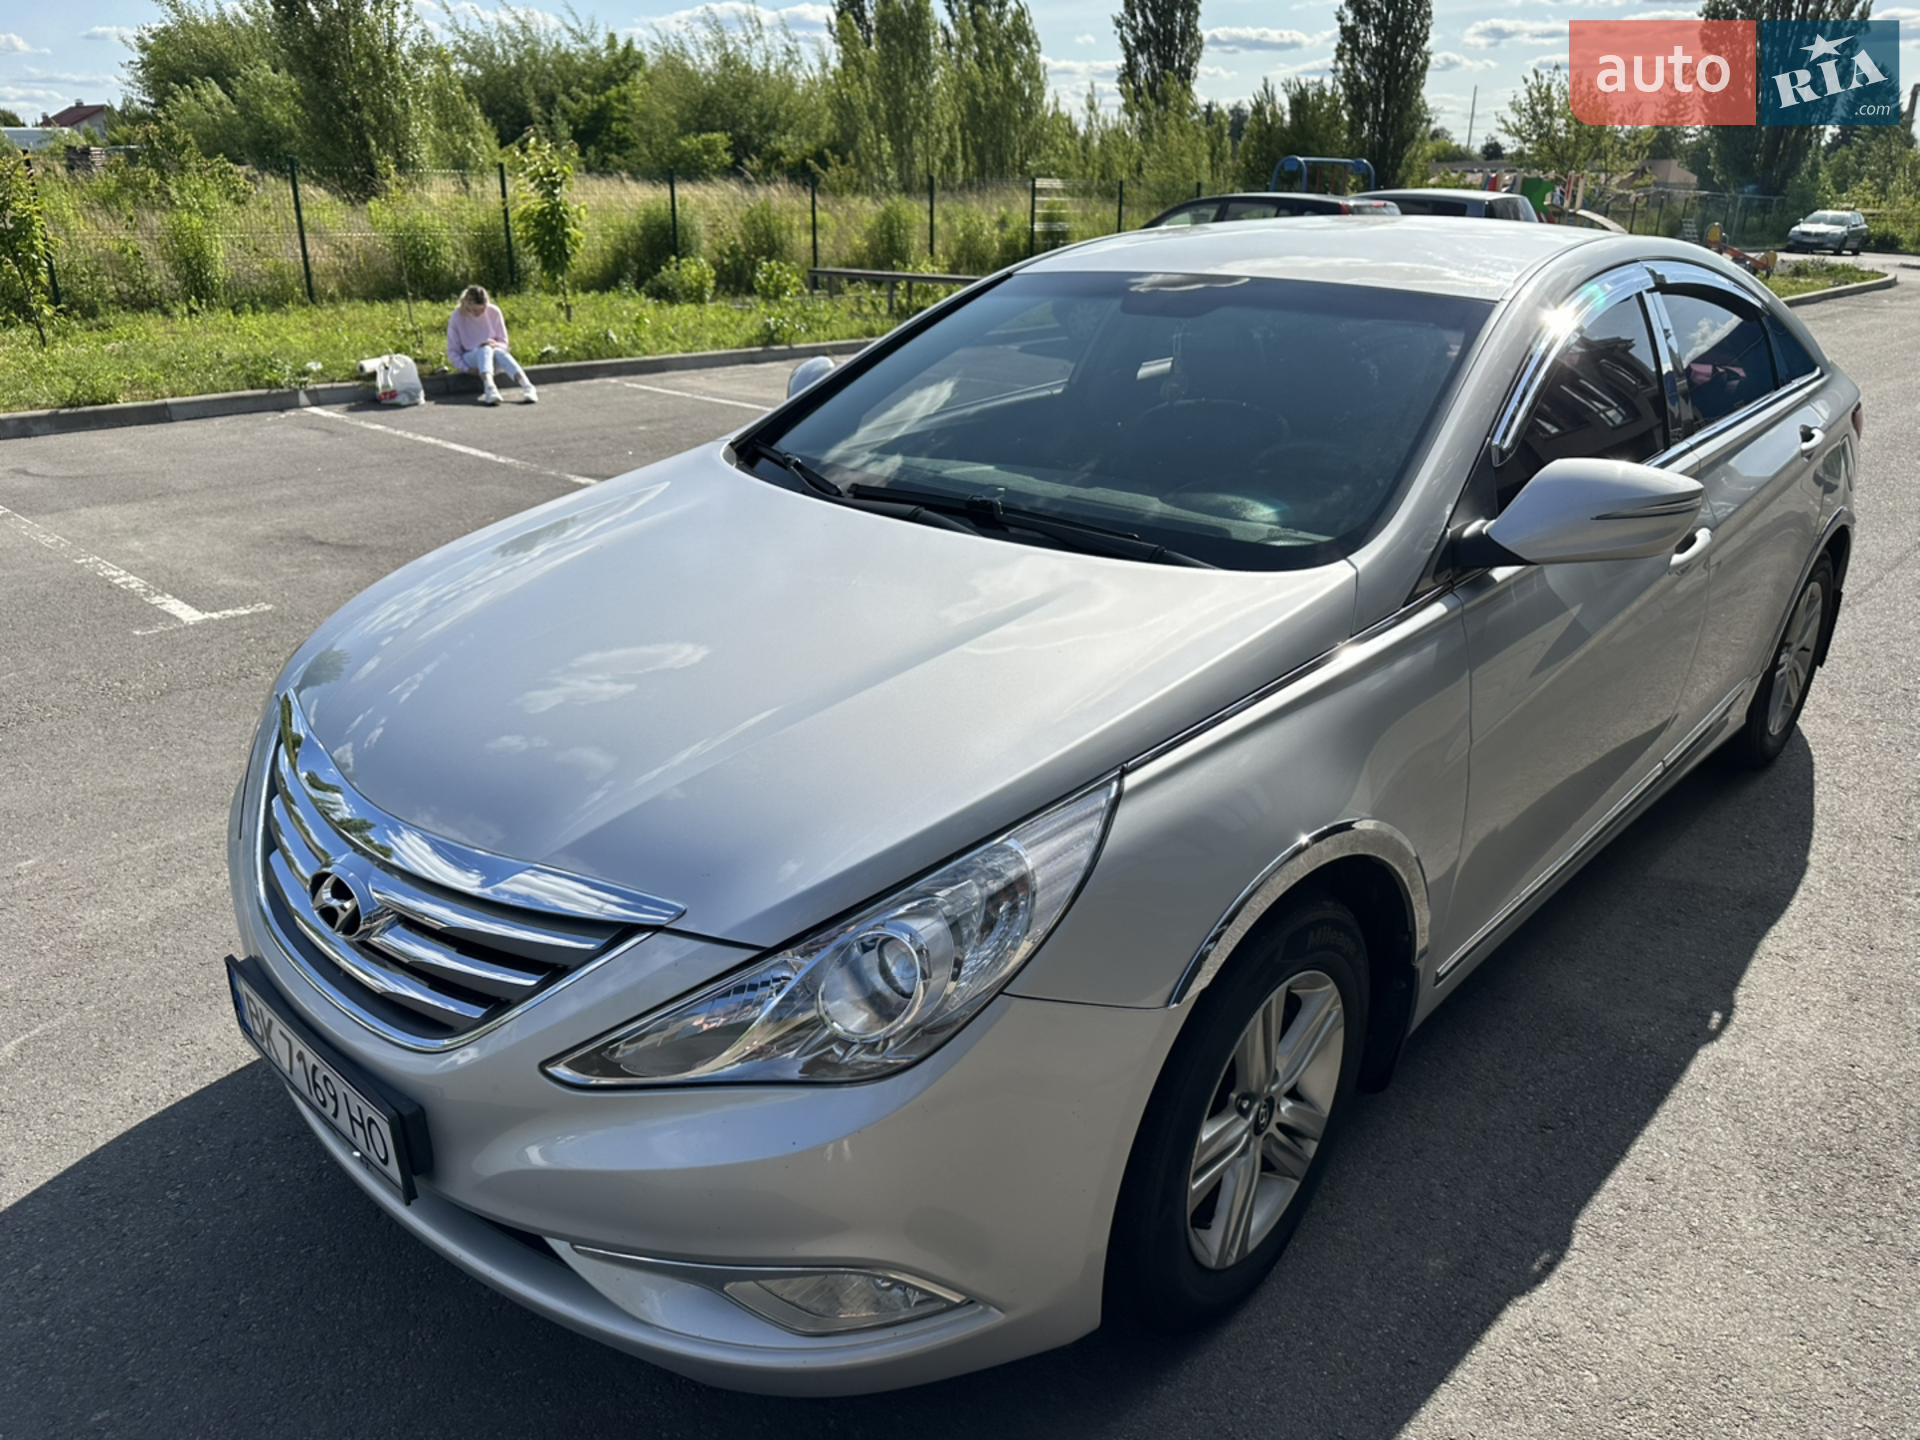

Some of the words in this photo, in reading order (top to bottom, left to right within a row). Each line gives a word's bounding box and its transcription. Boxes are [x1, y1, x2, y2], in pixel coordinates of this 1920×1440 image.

[1306, 925, 1357, 956] Mileage
[279, 1028, 339, 1119] 7169
[343, 1088, 389, 1166] HO
